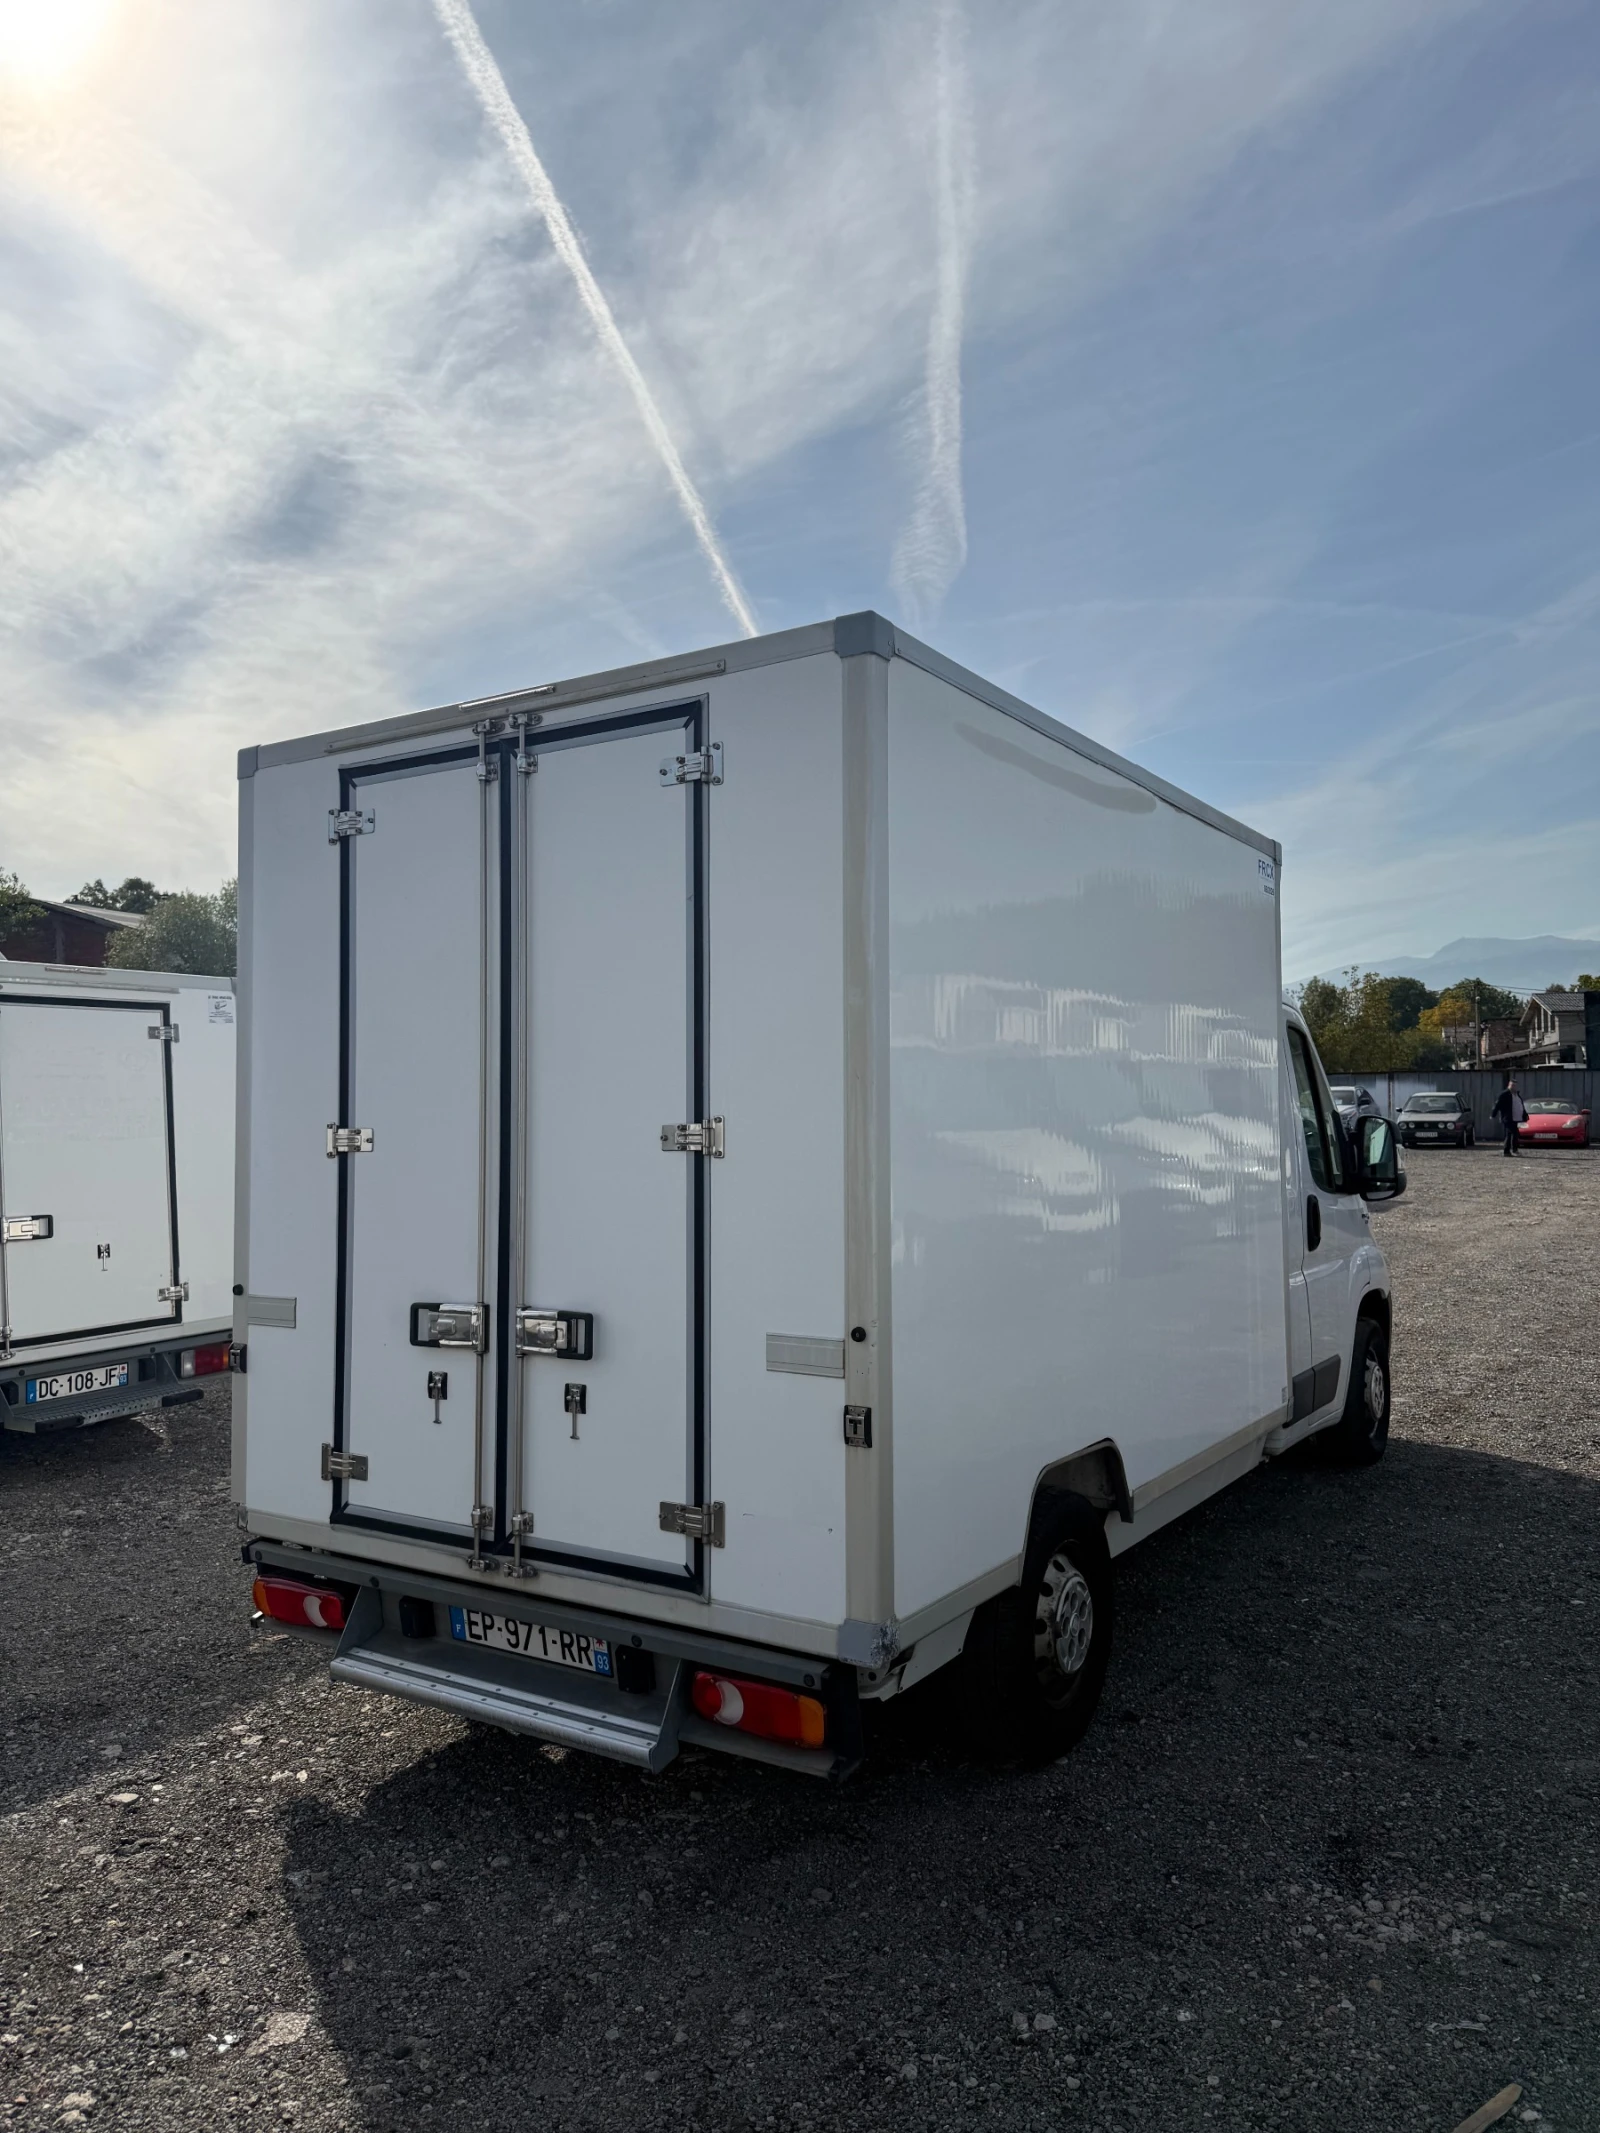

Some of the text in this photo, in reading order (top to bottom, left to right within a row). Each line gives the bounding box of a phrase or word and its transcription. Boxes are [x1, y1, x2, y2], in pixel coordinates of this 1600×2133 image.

[38, 1367, 118, 1399] DC-108-JF
[119, 1375, 127, 1383] 93
[456, 1624, 461, 1632] F
[467, 1610, 593, 1666] EP-971-RR
[597, 1655, 609, 1670] 93
